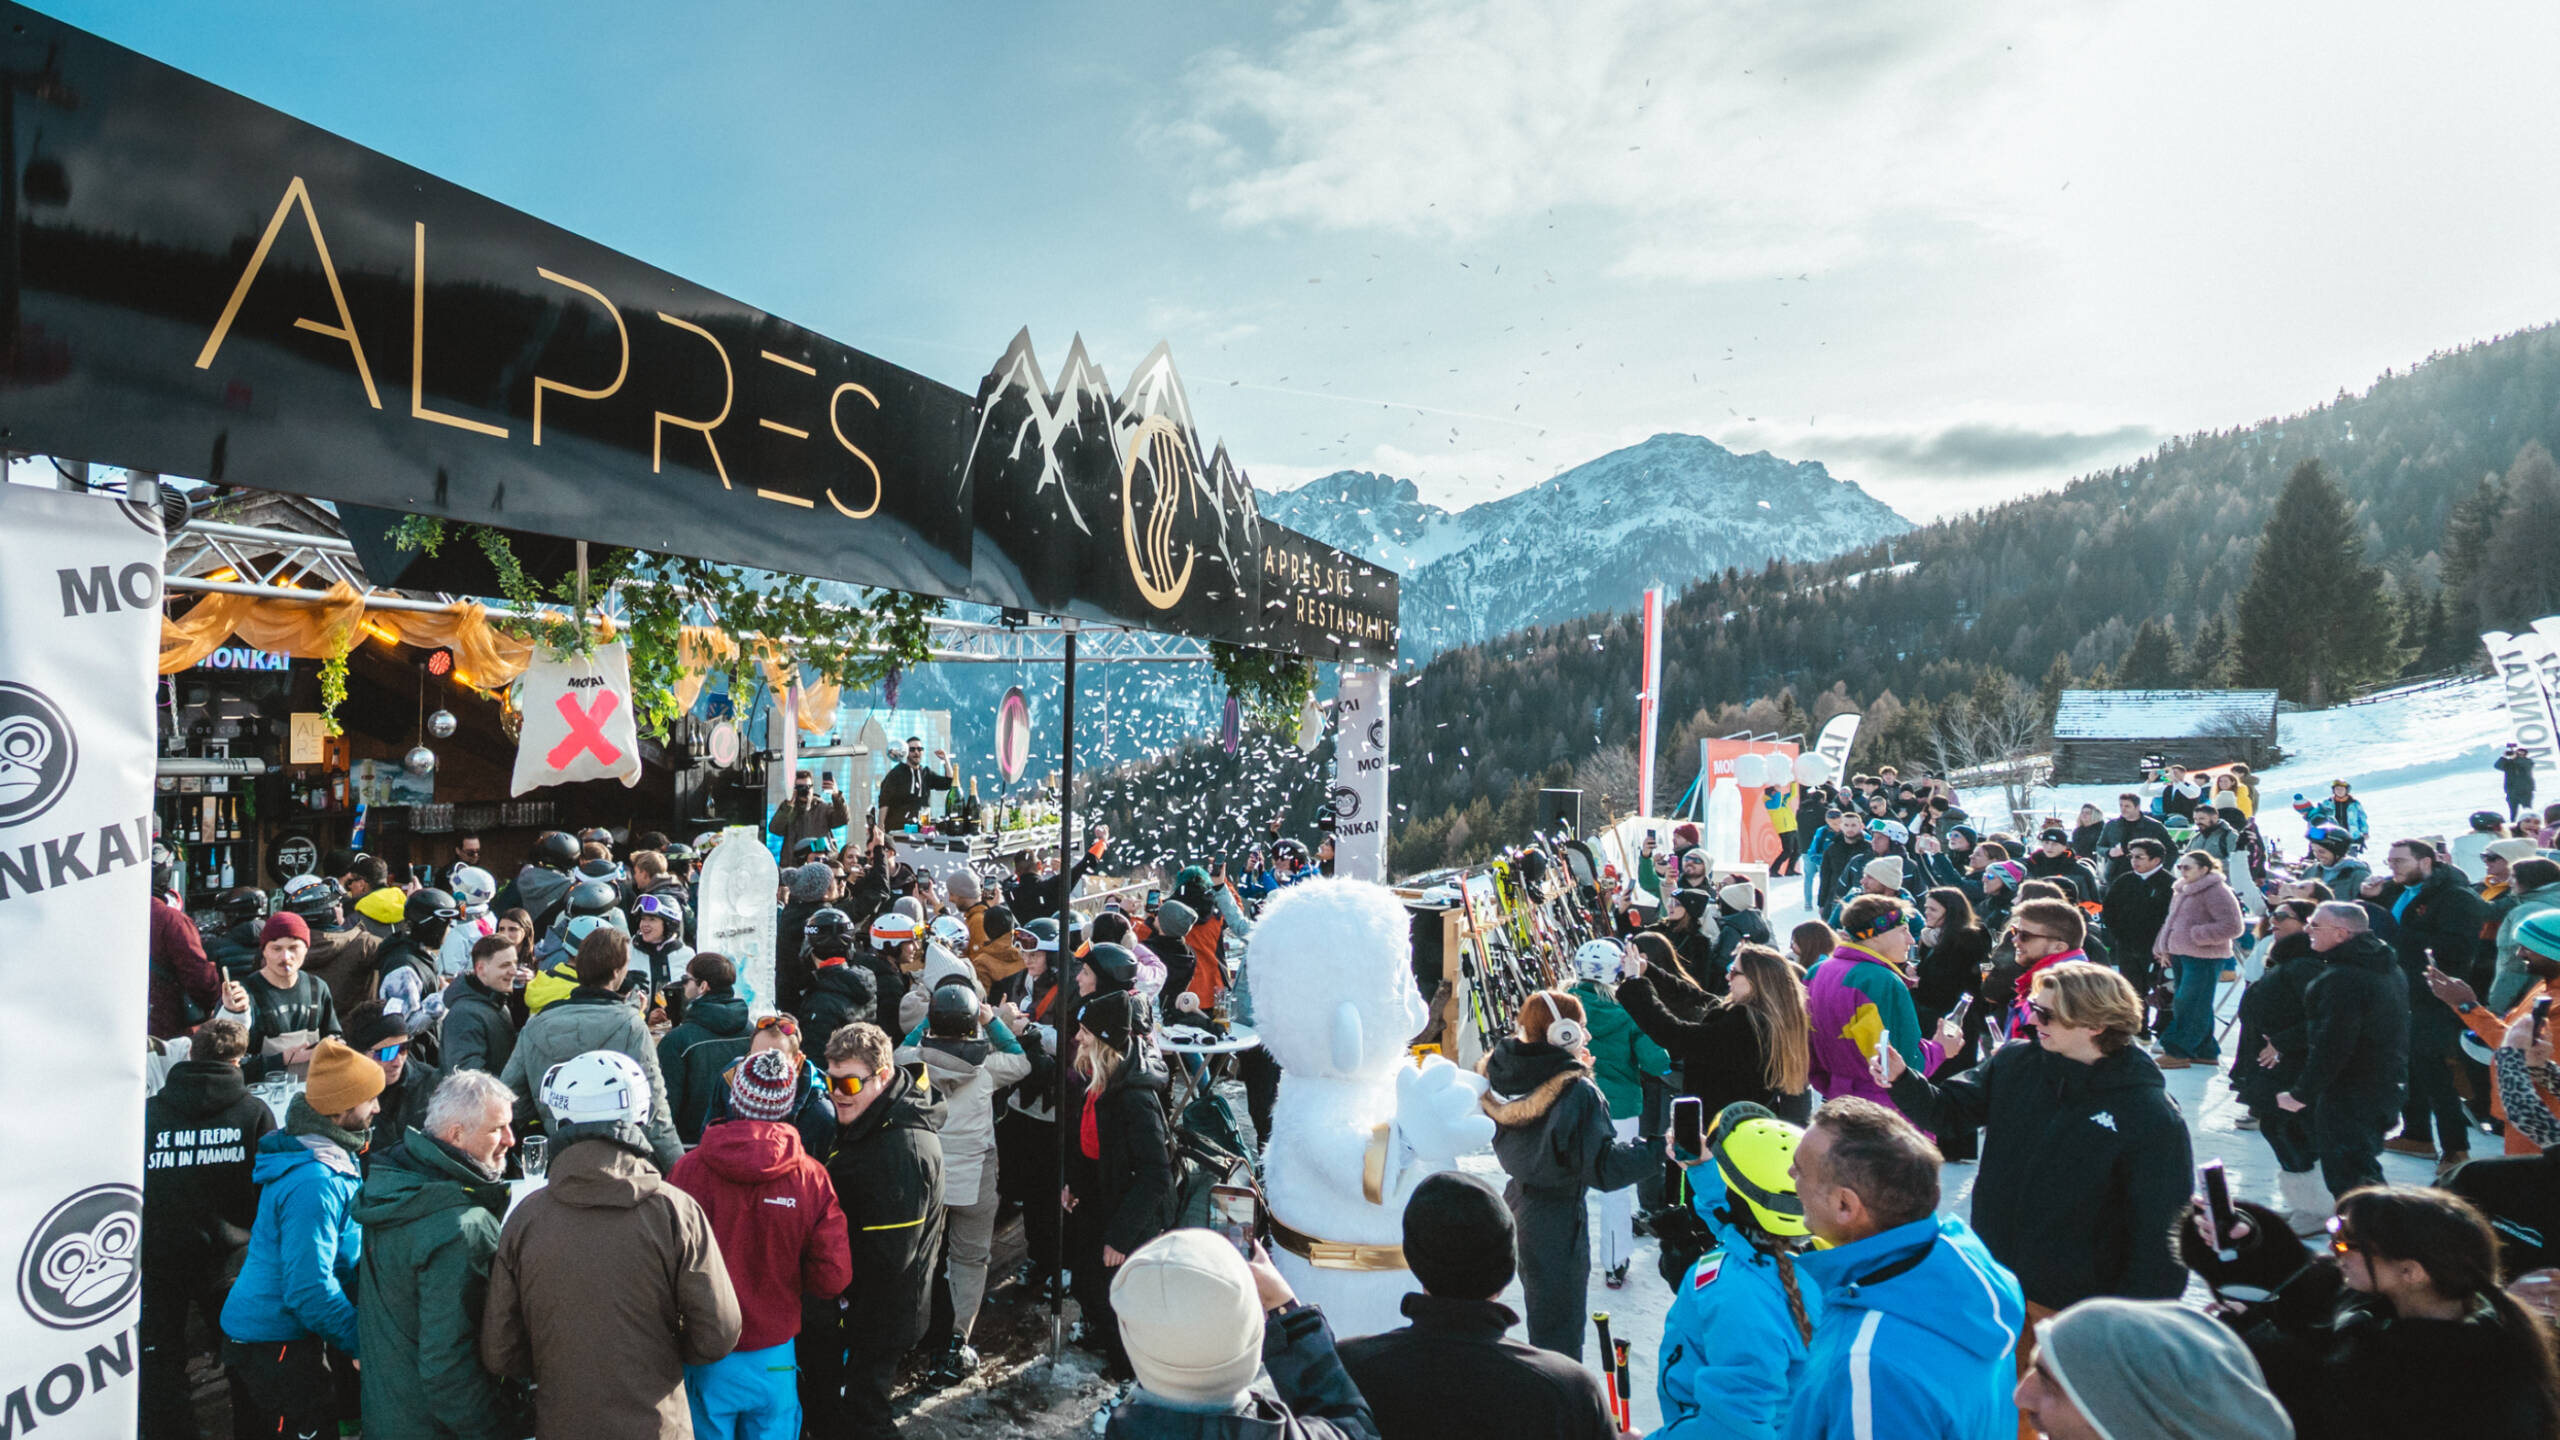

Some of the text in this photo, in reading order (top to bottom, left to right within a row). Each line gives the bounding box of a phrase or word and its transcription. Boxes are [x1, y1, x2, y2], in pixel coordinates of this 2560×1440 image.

[194, 175, 882, 520] ALPRES
[1297, 595, 1390, 642] RESTAURANT
[1357, 756, 1384, 772] MO
[155, 1128, 242, 1149] SE HAI FREDDO
[147, 1146, 245, 1169] STAI IN PIANURA
[0, 1321, 140, 1440] MON
